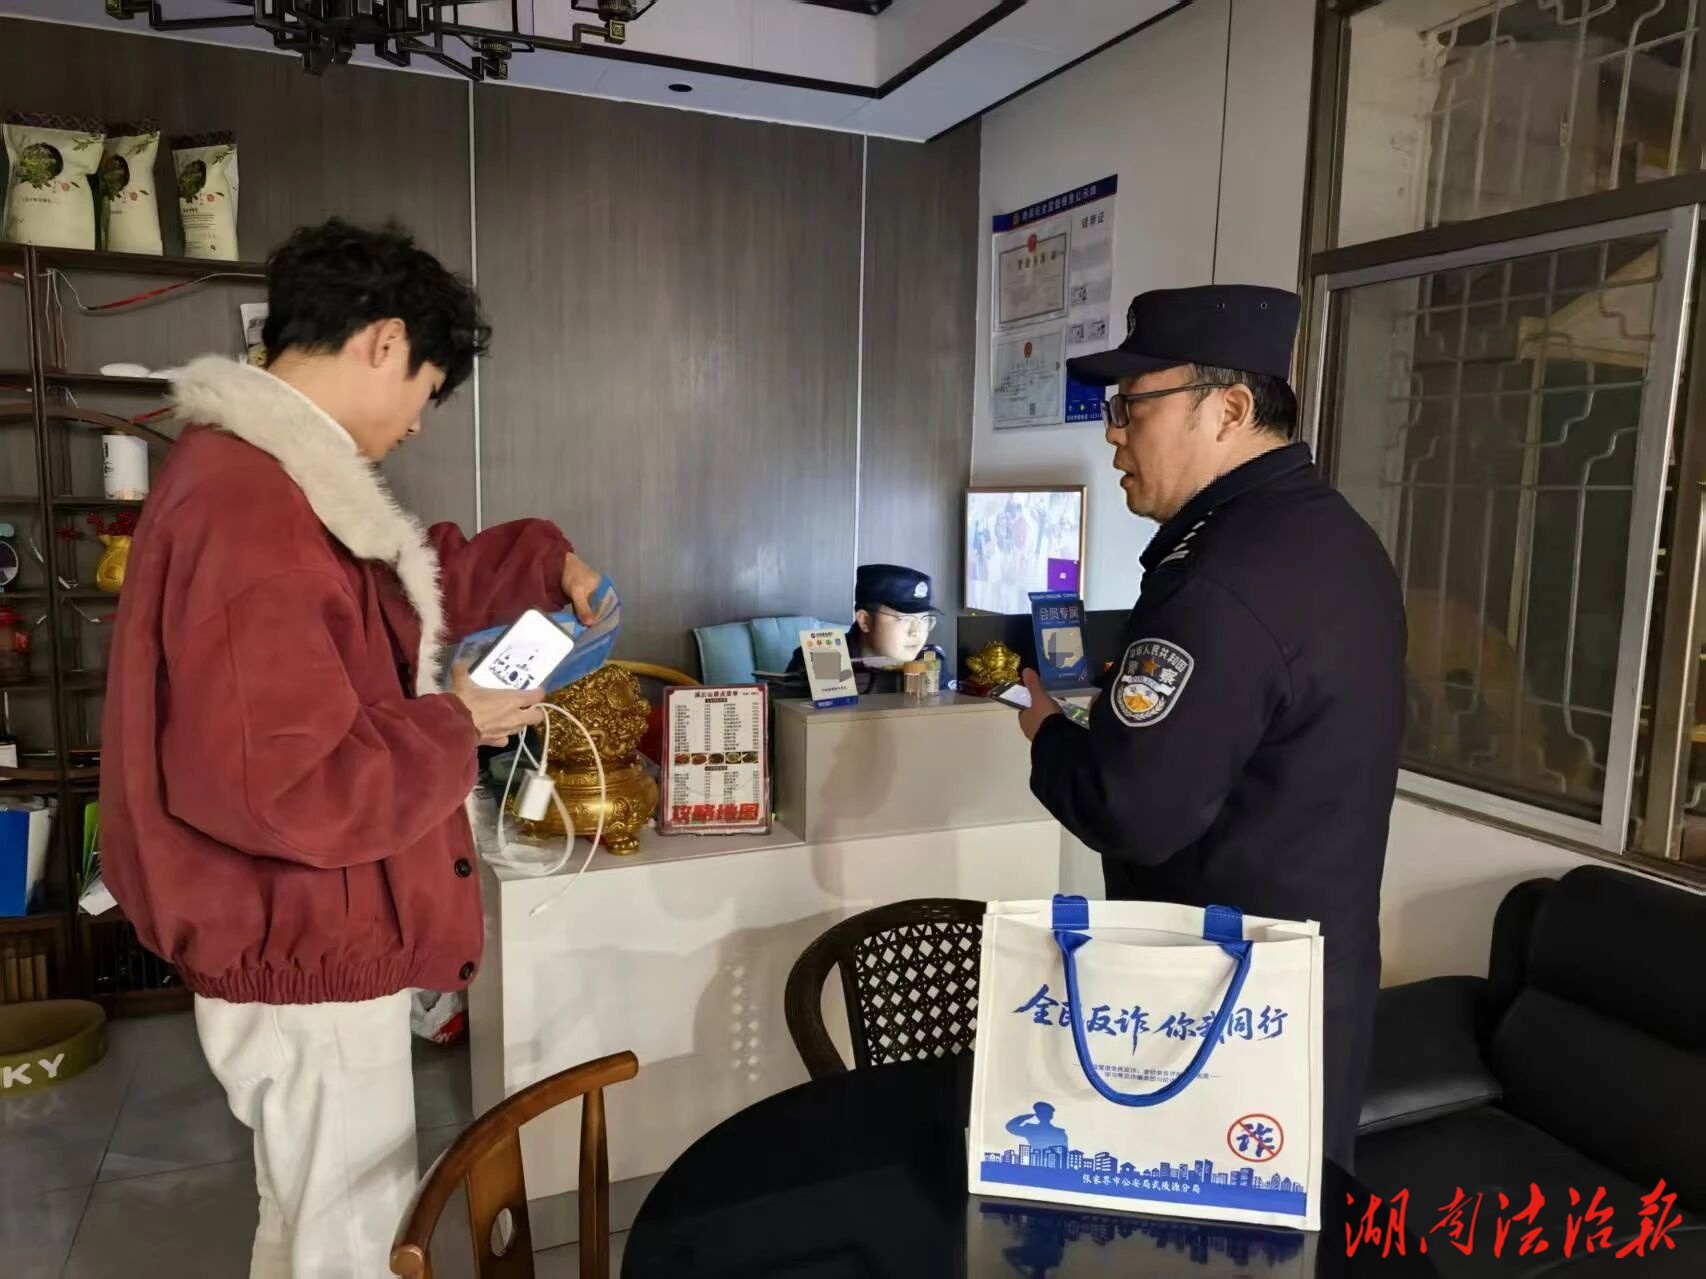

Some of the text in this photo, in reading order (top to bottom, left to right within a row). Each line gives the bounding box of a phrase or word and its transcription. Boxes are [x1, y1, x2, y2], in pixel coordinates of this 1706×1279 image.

[1039, 606, 1080, 621] 会员专属
[1129, 644, 1188, 673] 中华人民共和国
[0, 1053, 65, 1088] KY
[1236, 1122, 1275, 1158] 诈
[1082, 1174, 1201, 1195] 张家界市公安局武陵源分局
